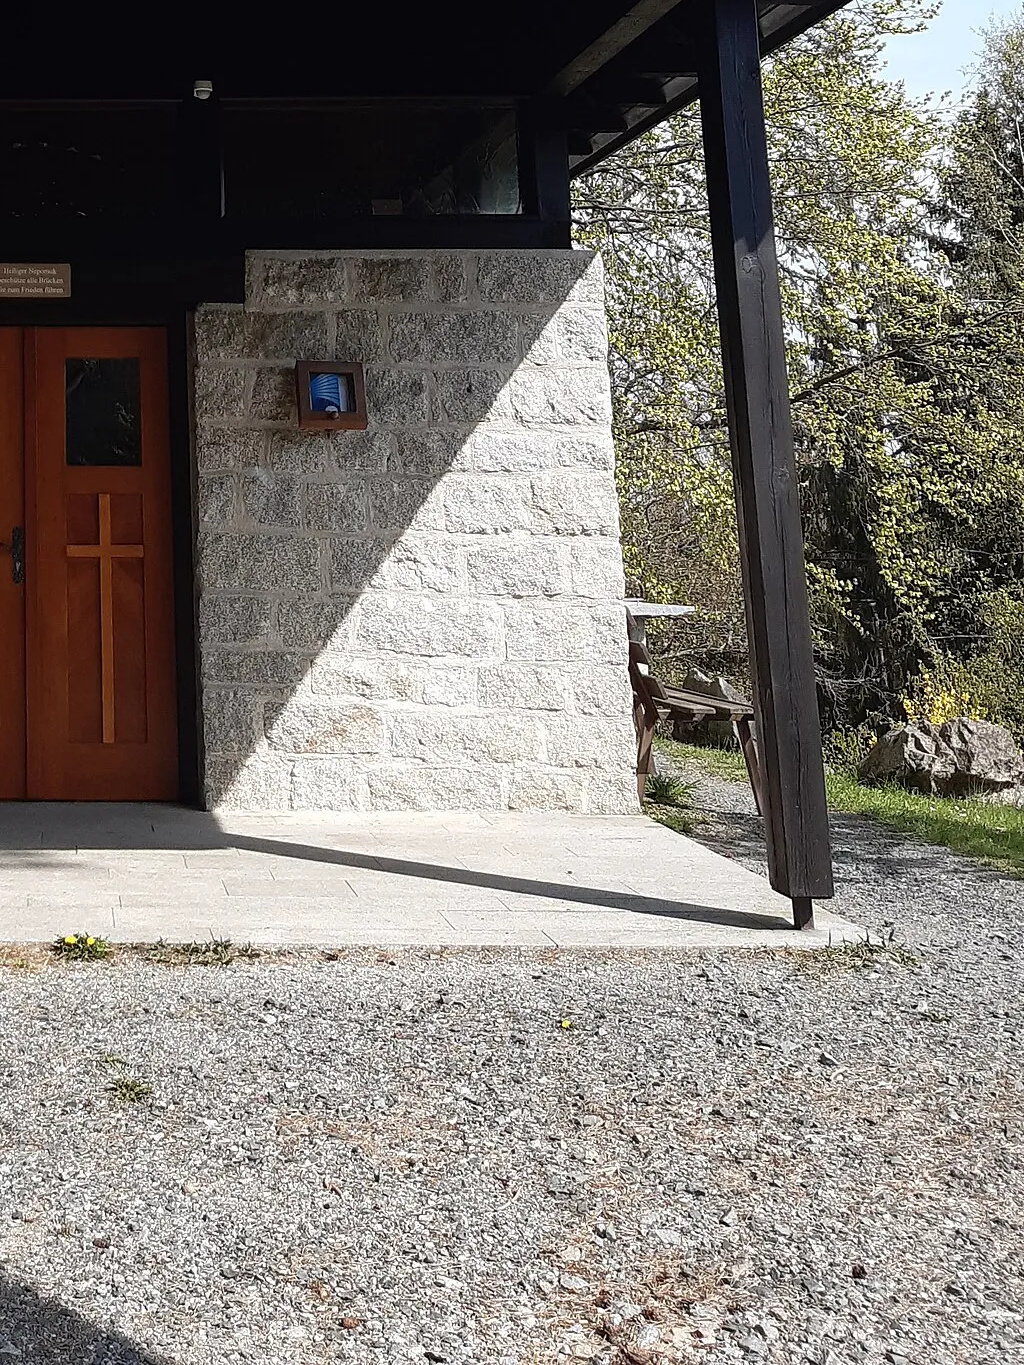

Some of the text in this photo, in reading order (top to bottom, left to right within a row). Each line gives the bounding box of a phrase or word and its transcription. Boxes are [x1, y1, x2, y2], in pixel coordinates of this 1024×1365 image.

[2, 267, 57, 276] Heiliger Nepomuk
[27, 276, 38, 284] alle
[39, 276, 64, 284] Brücken
[44, 286, 64, 294] führen
